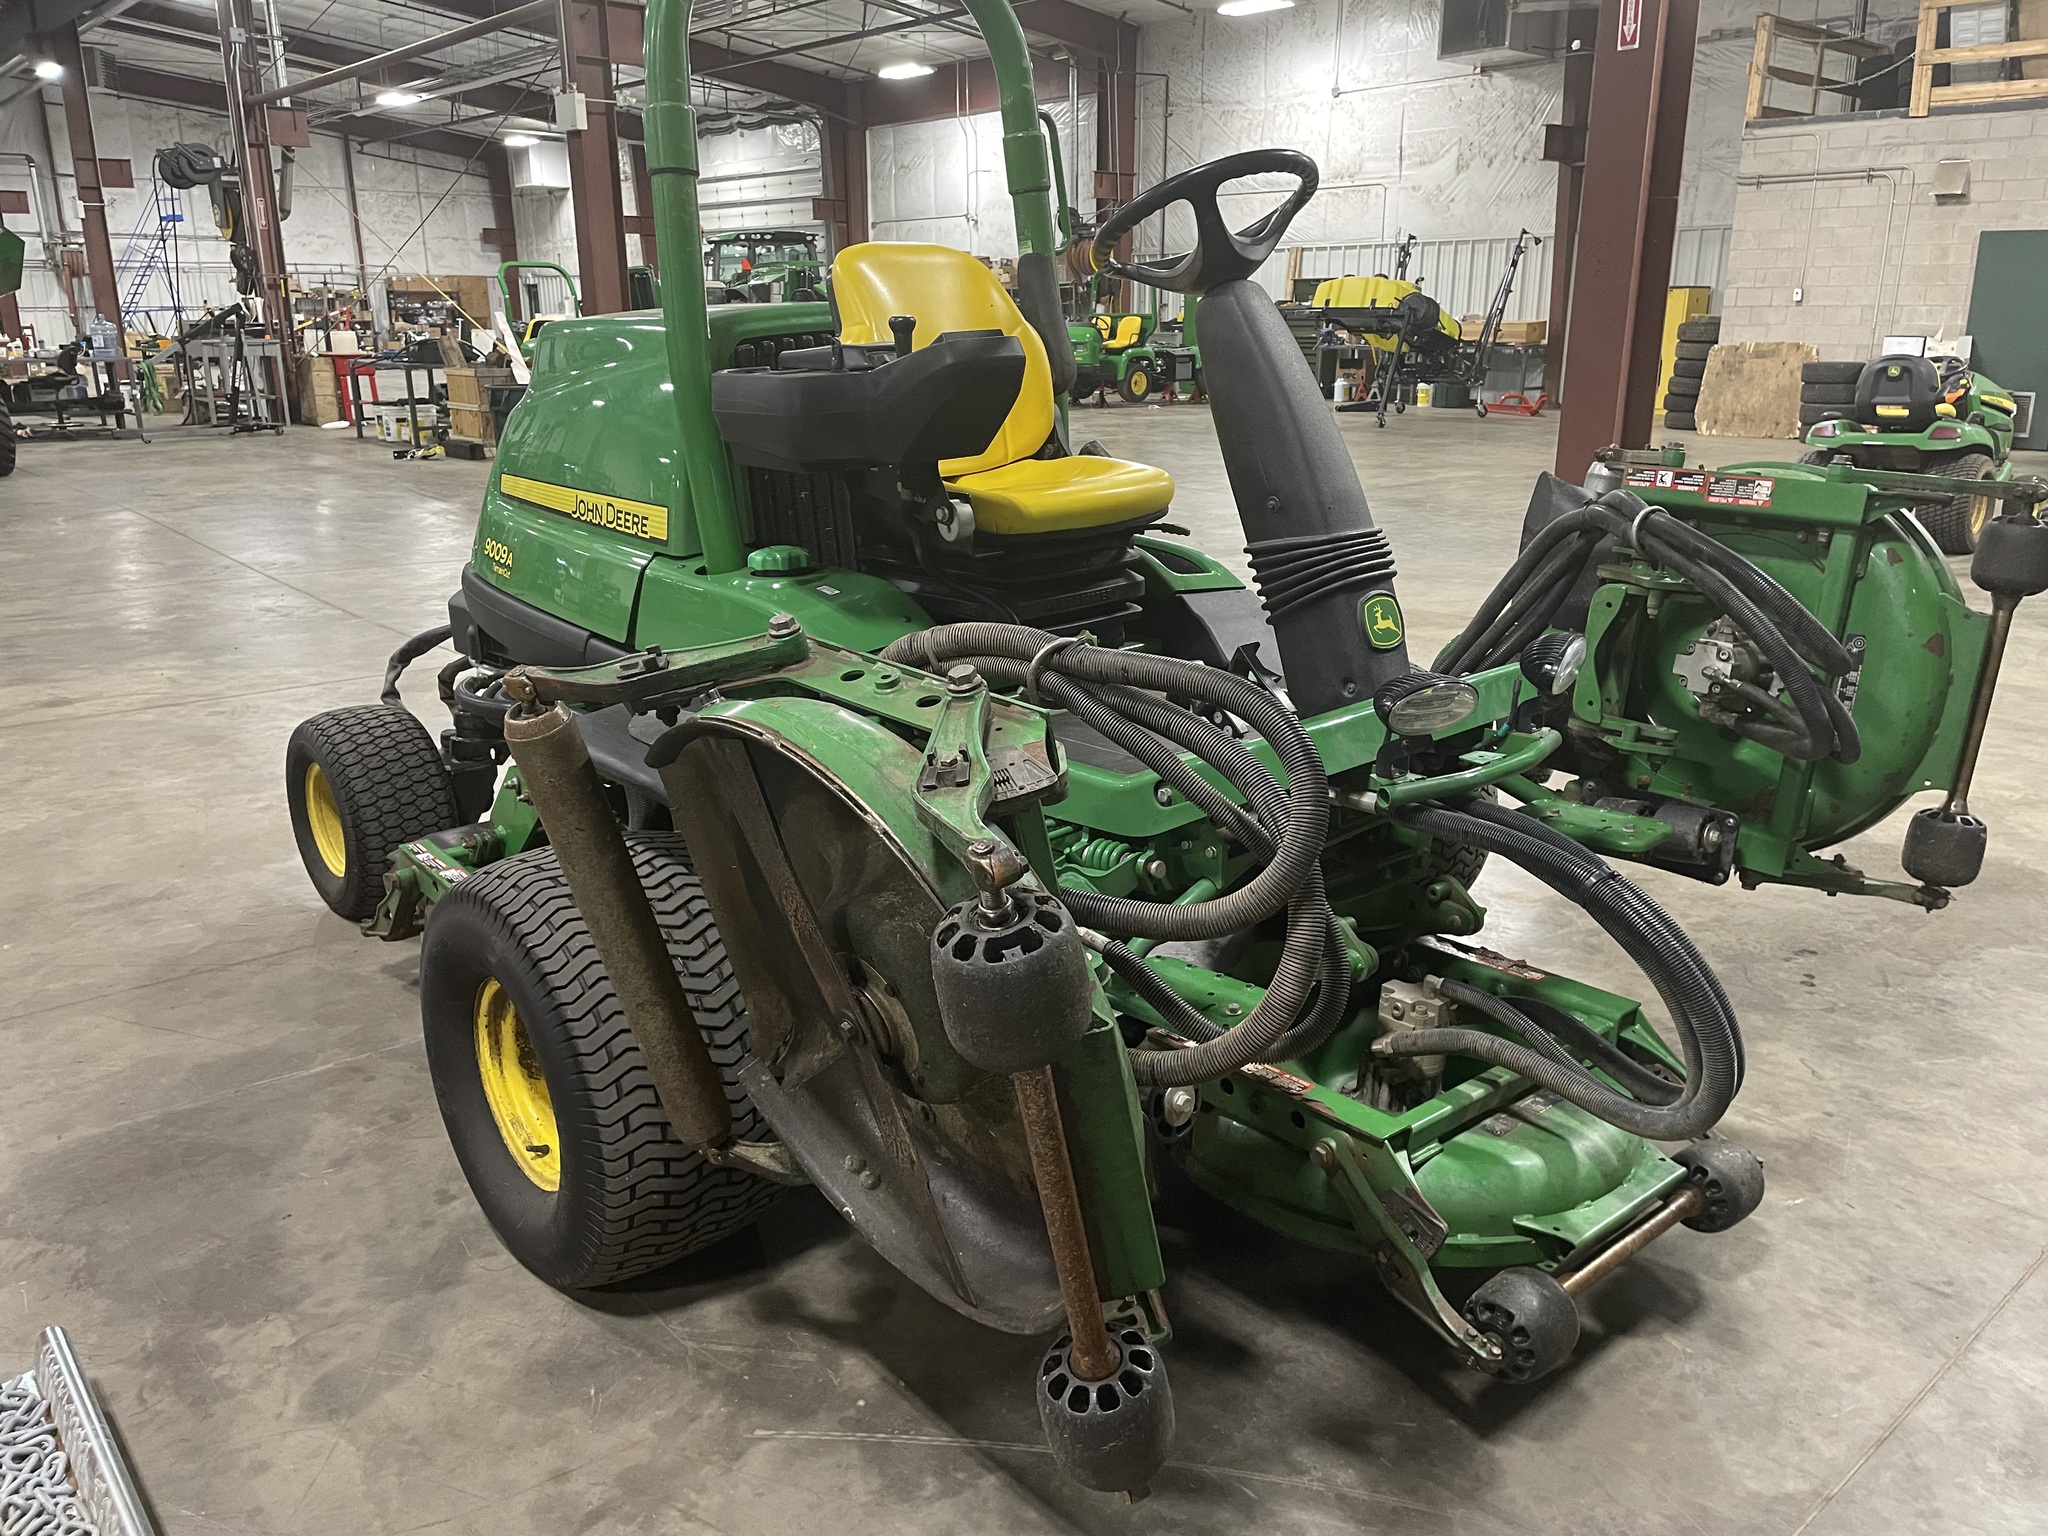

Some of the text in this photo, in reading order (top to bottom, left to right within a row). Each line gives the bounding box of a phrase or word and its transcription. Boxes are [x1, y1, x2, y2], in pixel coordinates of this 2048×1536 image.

[571, 494, 649, 535] JOHN DEERE
[484, 537, 513, 567] 9009A
